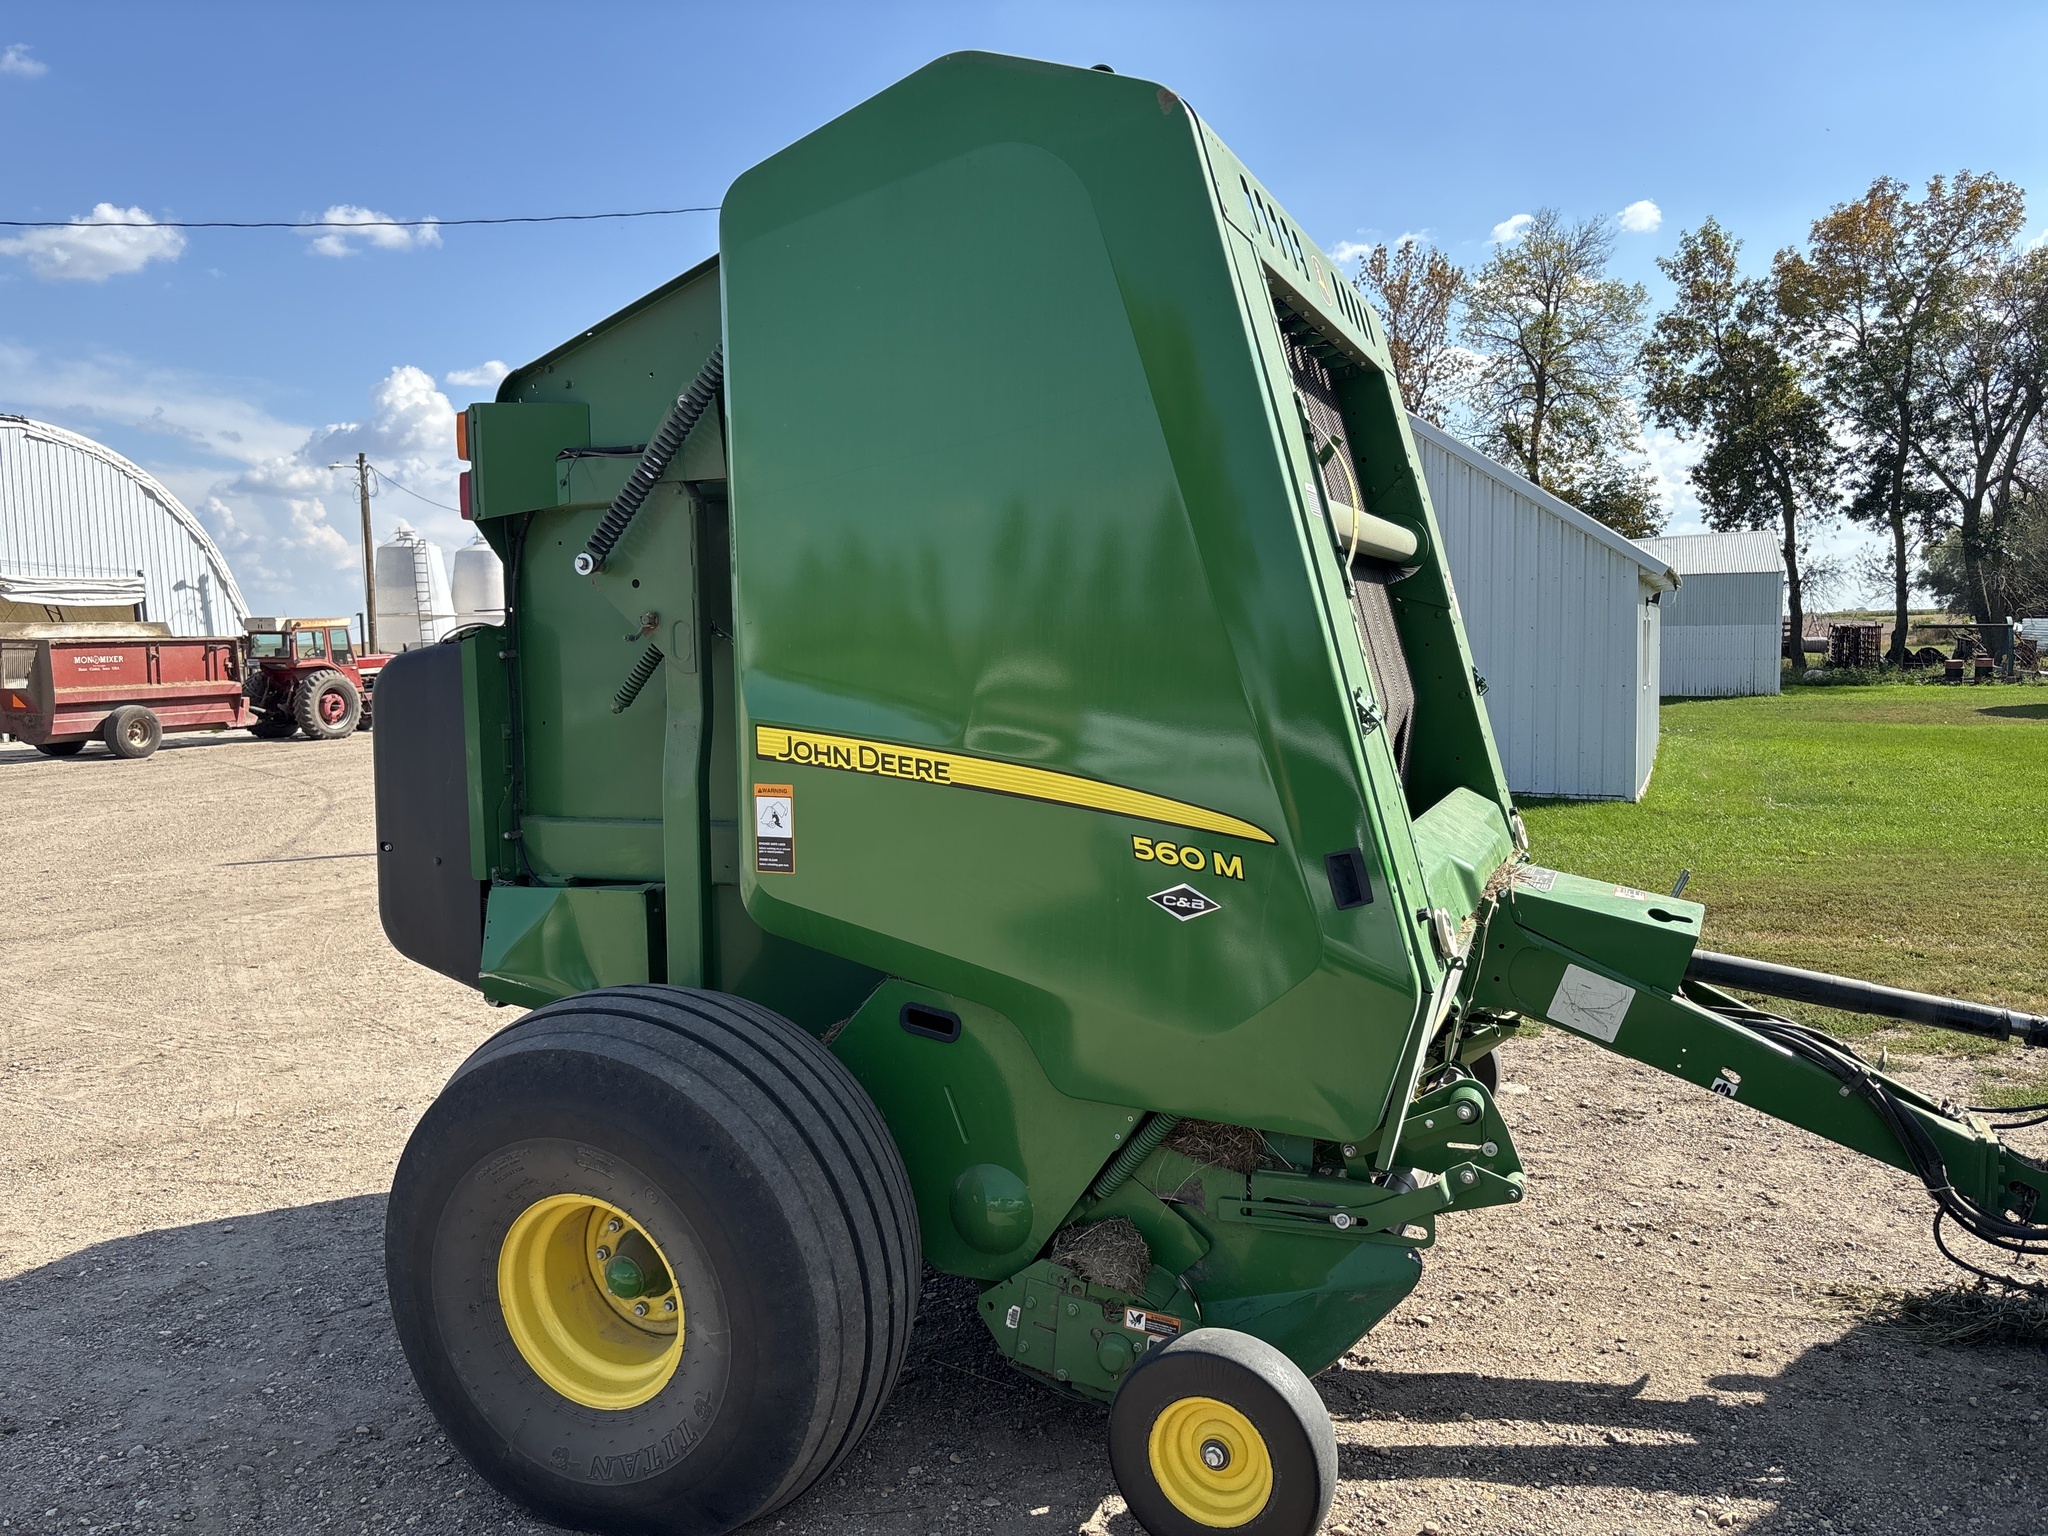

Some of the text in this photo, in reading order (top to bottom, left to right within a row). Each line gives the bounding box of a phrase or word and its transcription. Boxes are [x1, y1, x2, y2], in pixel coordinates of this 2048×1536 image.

[778, 735, 951, 781] JOHN DEERE
[1132, 835, 1244, 880] 560 M
[1163, 895, 1205, 909] C&B
[587, 1418, 699, 1482] TITAN
